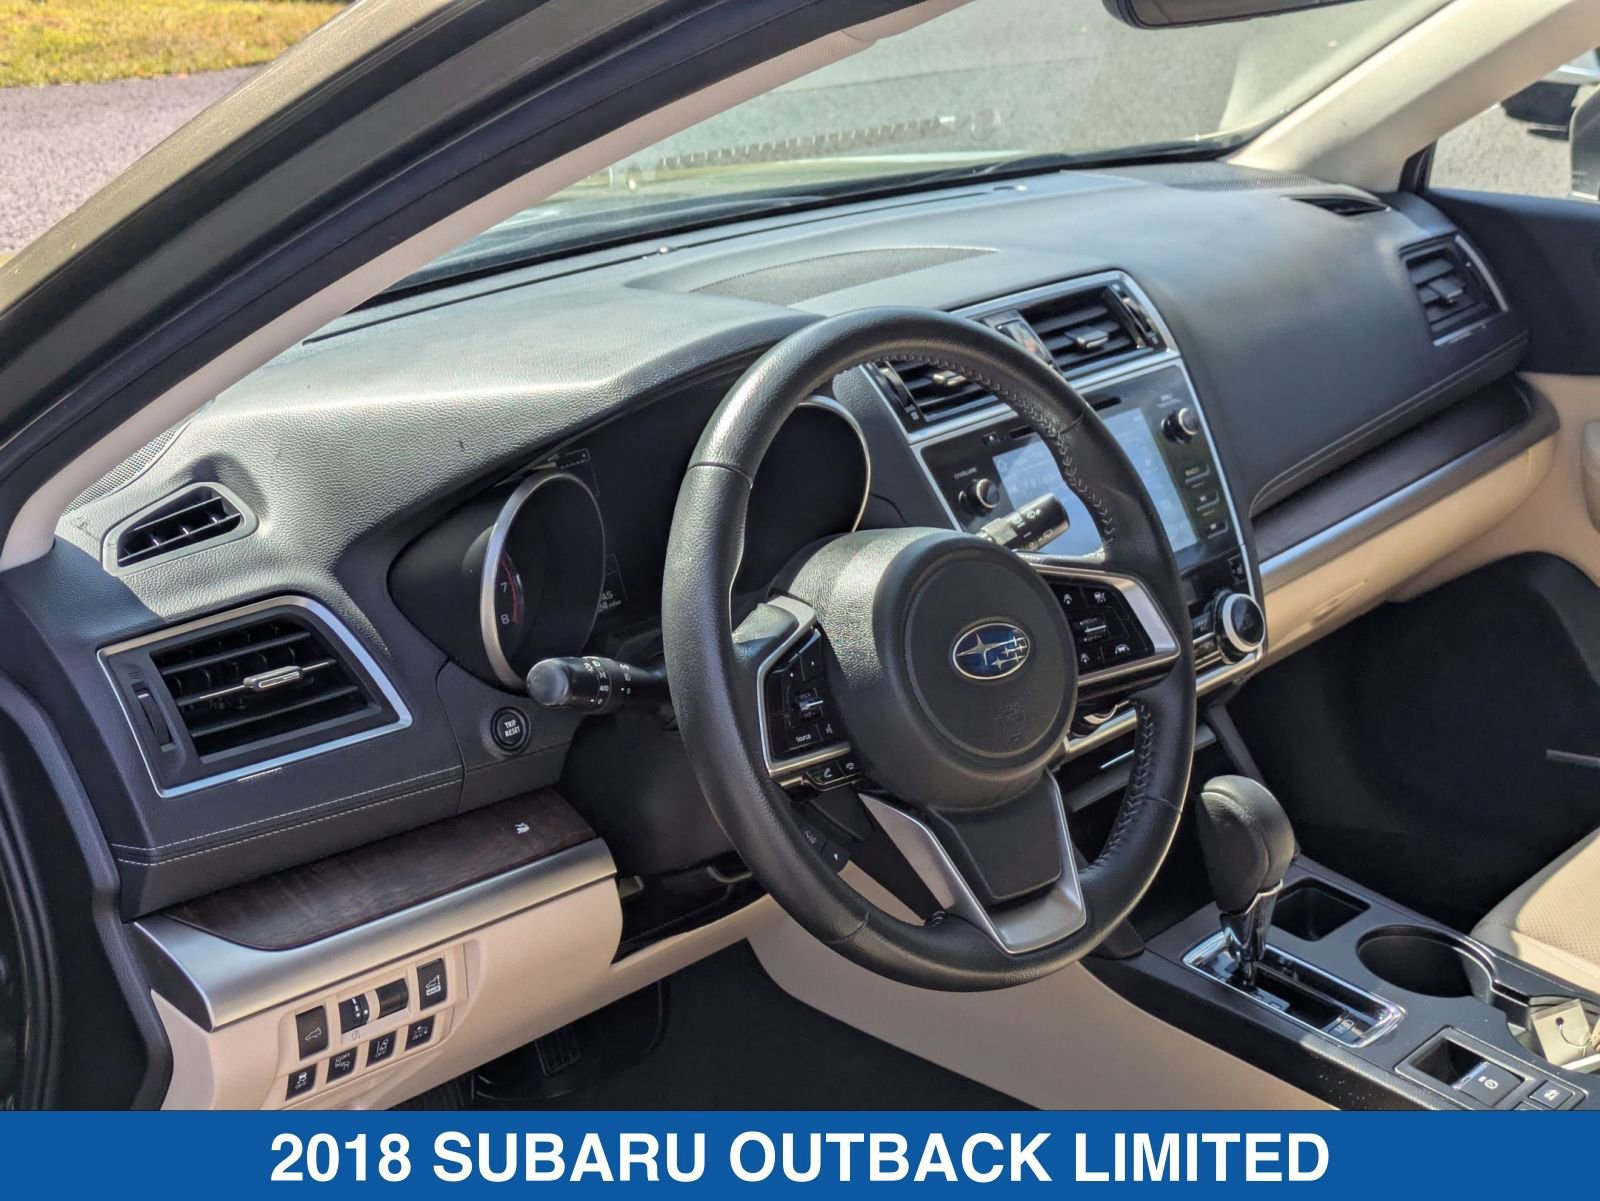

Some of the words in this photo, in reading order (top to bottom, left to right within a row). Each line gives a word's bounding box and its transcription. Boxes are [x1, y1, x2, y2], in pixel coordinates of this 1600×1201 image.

[500, 581, 508, 592] 7
[501, 614, 509, 625] 8
[504, 719, 517, 728] TRIP
[504, 726, 521, 737] RESET
[795, 734, 811, 743] Source
